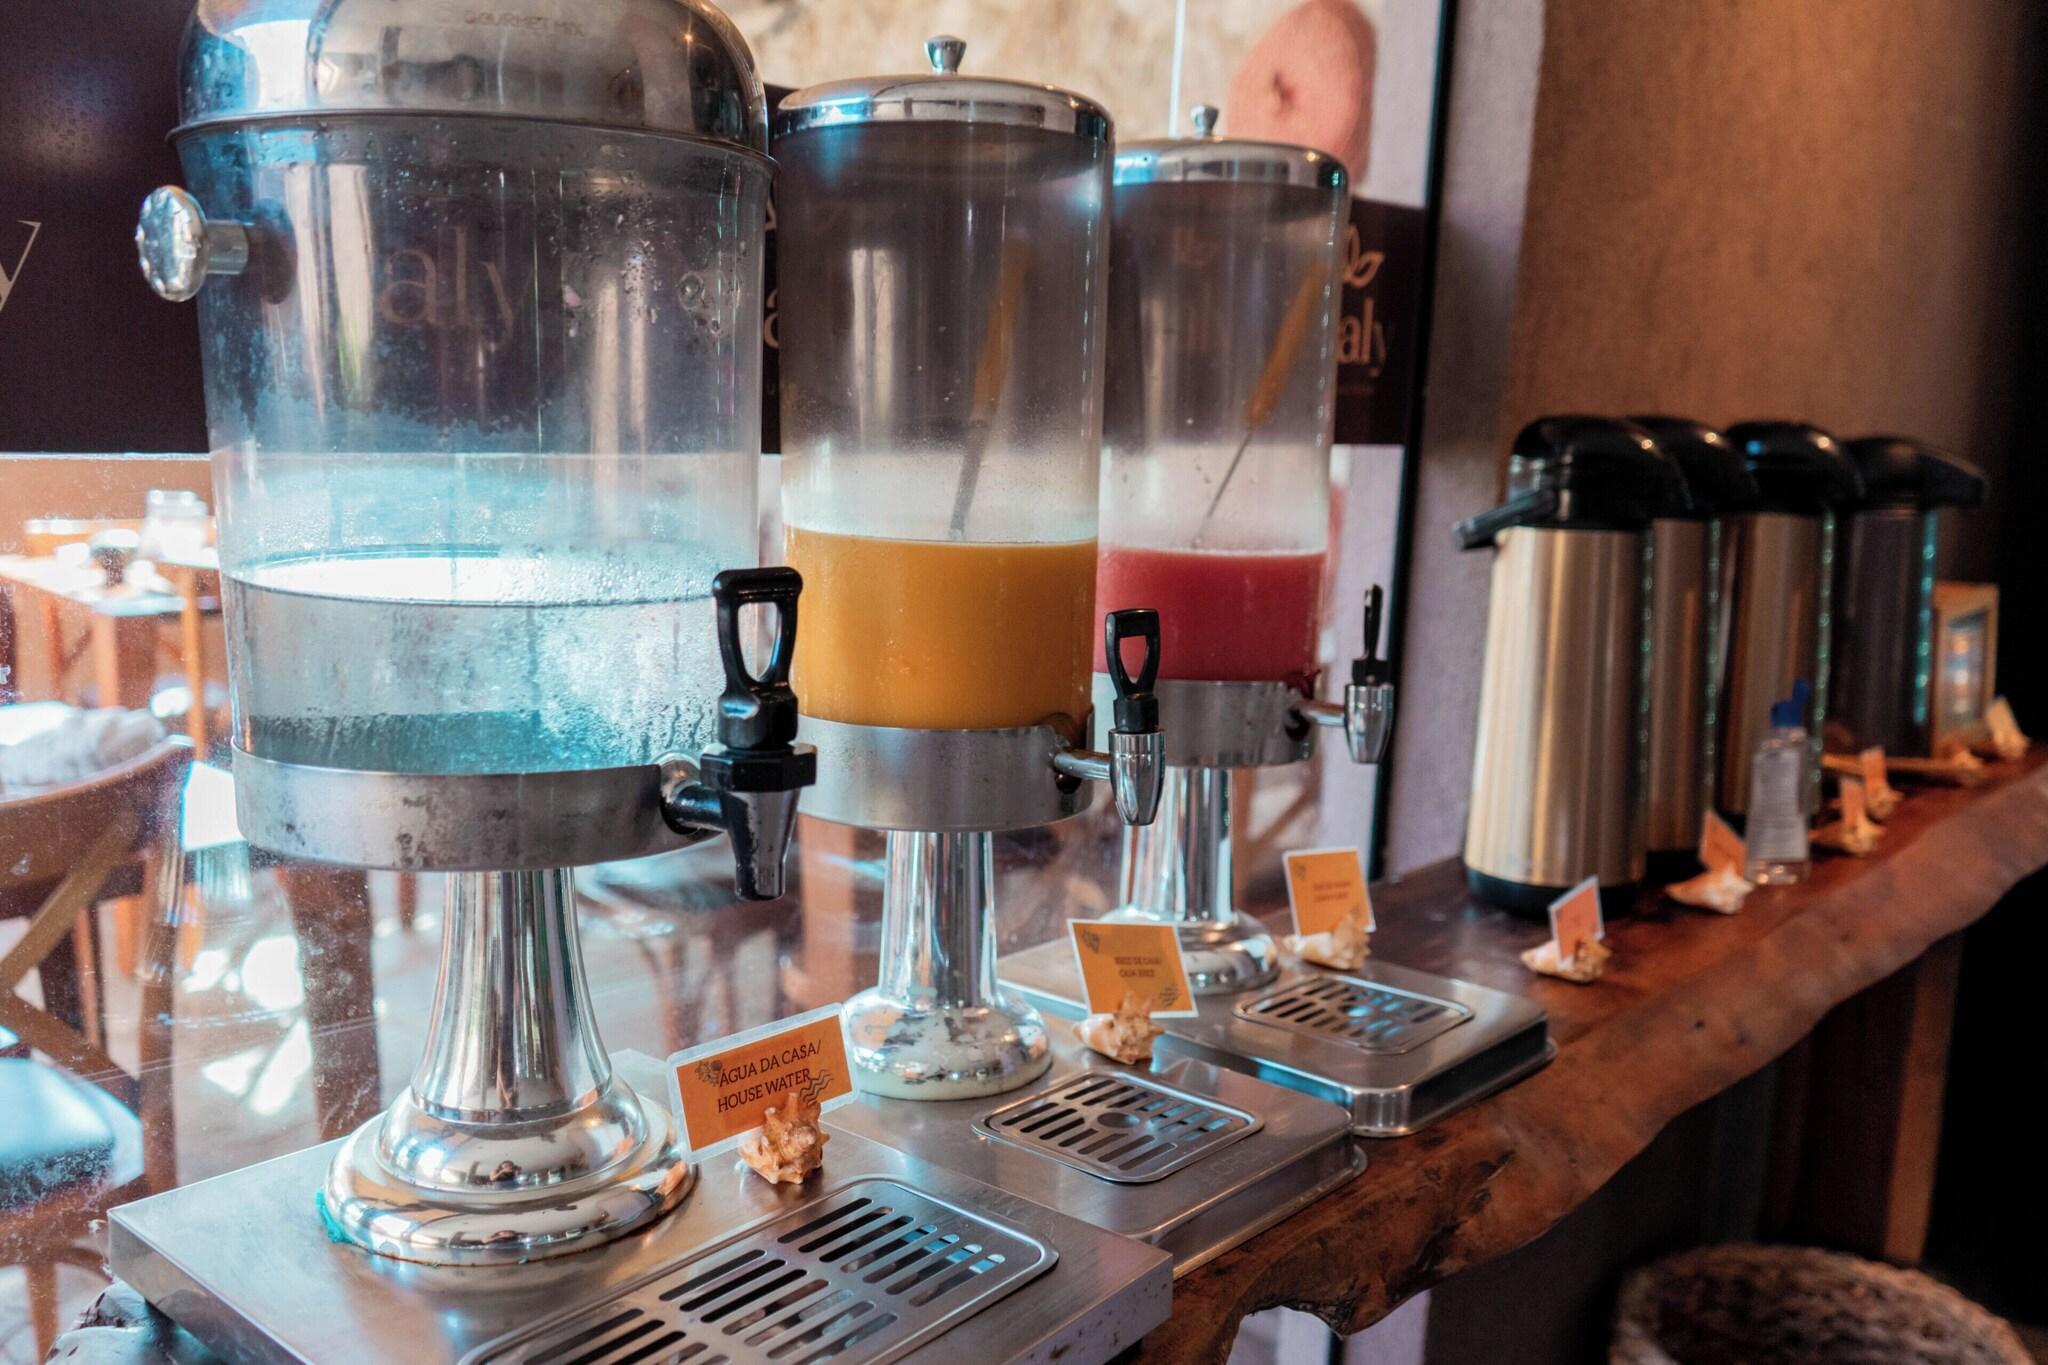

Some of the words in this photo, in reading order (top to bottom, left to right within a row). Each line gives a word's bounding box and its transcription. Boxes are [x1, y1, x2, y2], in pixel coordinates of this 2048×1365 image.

[760, 1055, 780, 1073] DA
[781, 1040, 821, 1065] CASA/
[718, 1083, 764, 1113] HOUSE
[765, 1068, 811, 1095] WATER
